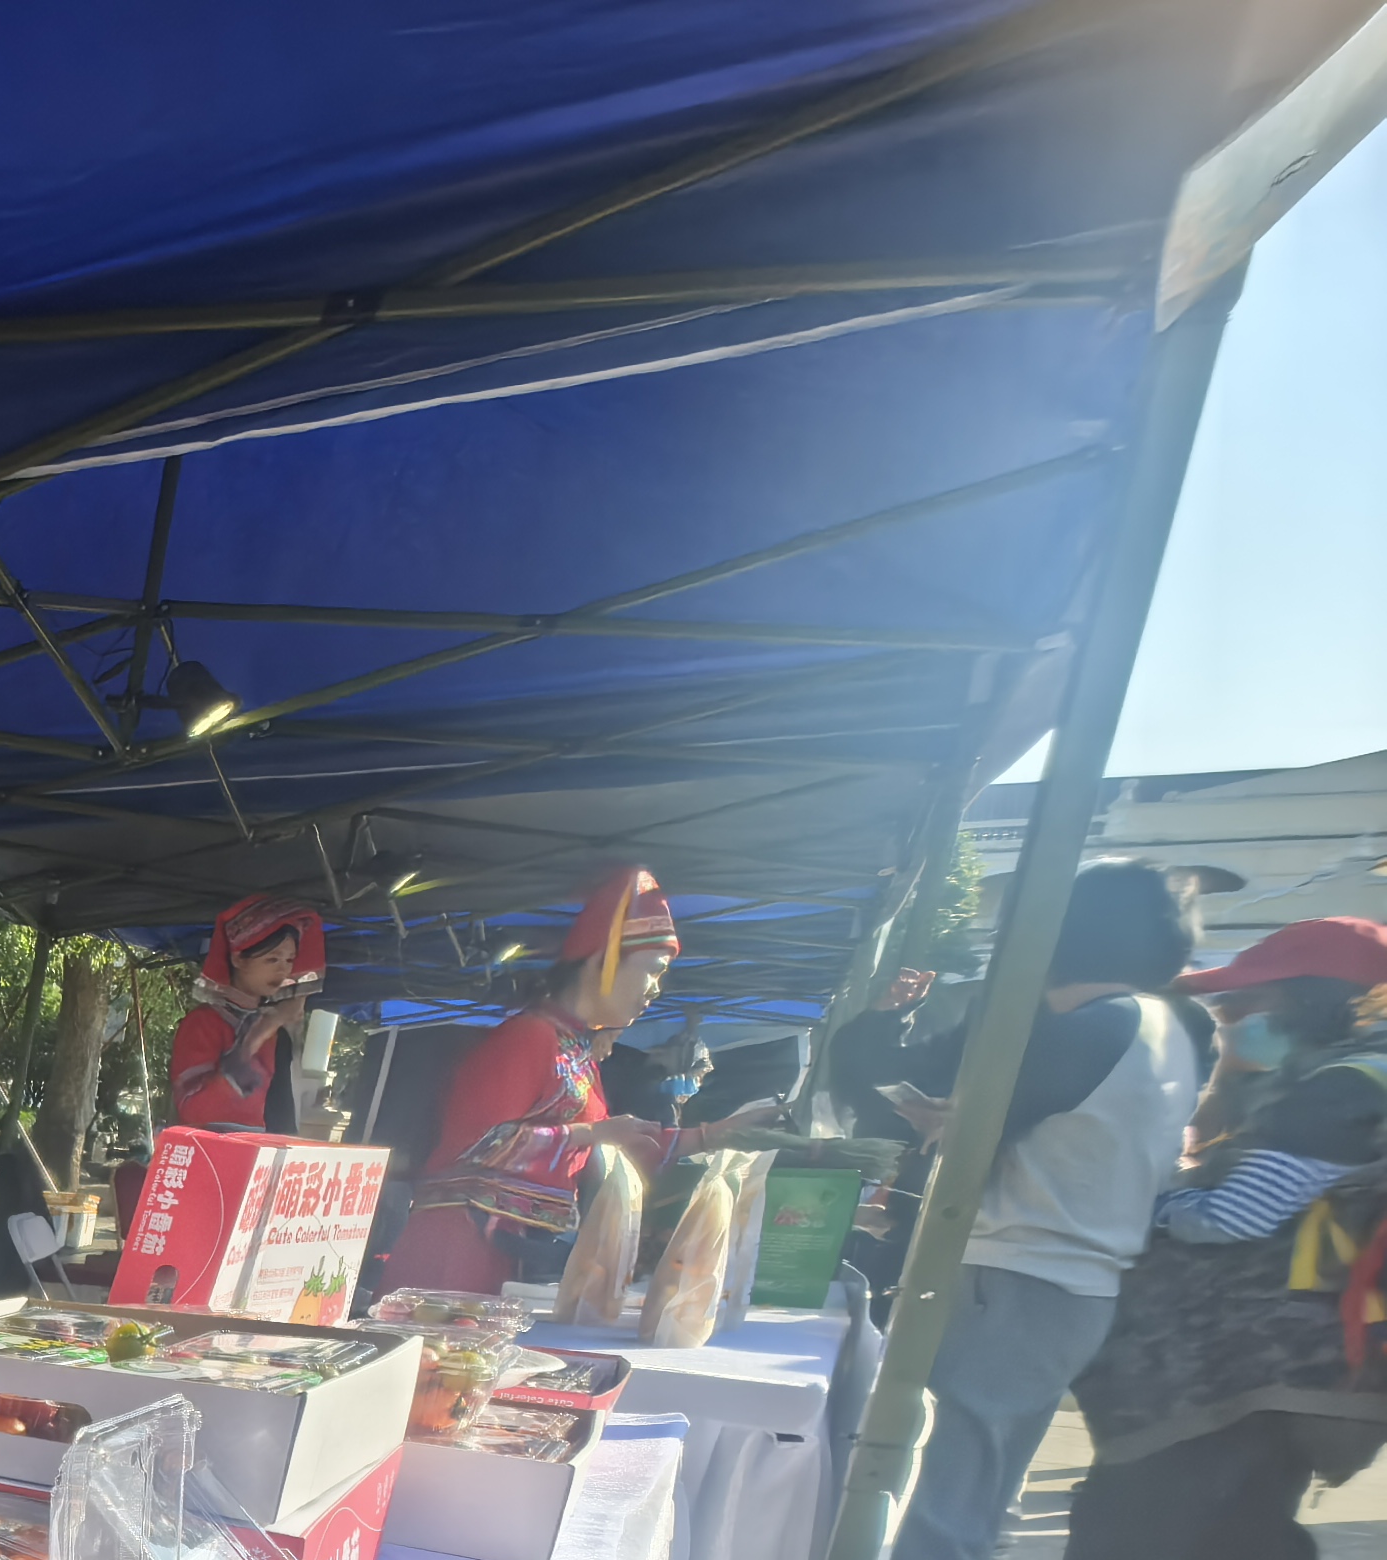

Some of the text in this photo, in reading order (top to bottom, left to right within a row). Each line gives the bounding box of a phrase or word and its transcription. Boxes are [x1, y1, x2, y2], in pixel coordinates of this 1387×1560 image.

[274, 1161, 383, 1218] 萌彩小番茄
